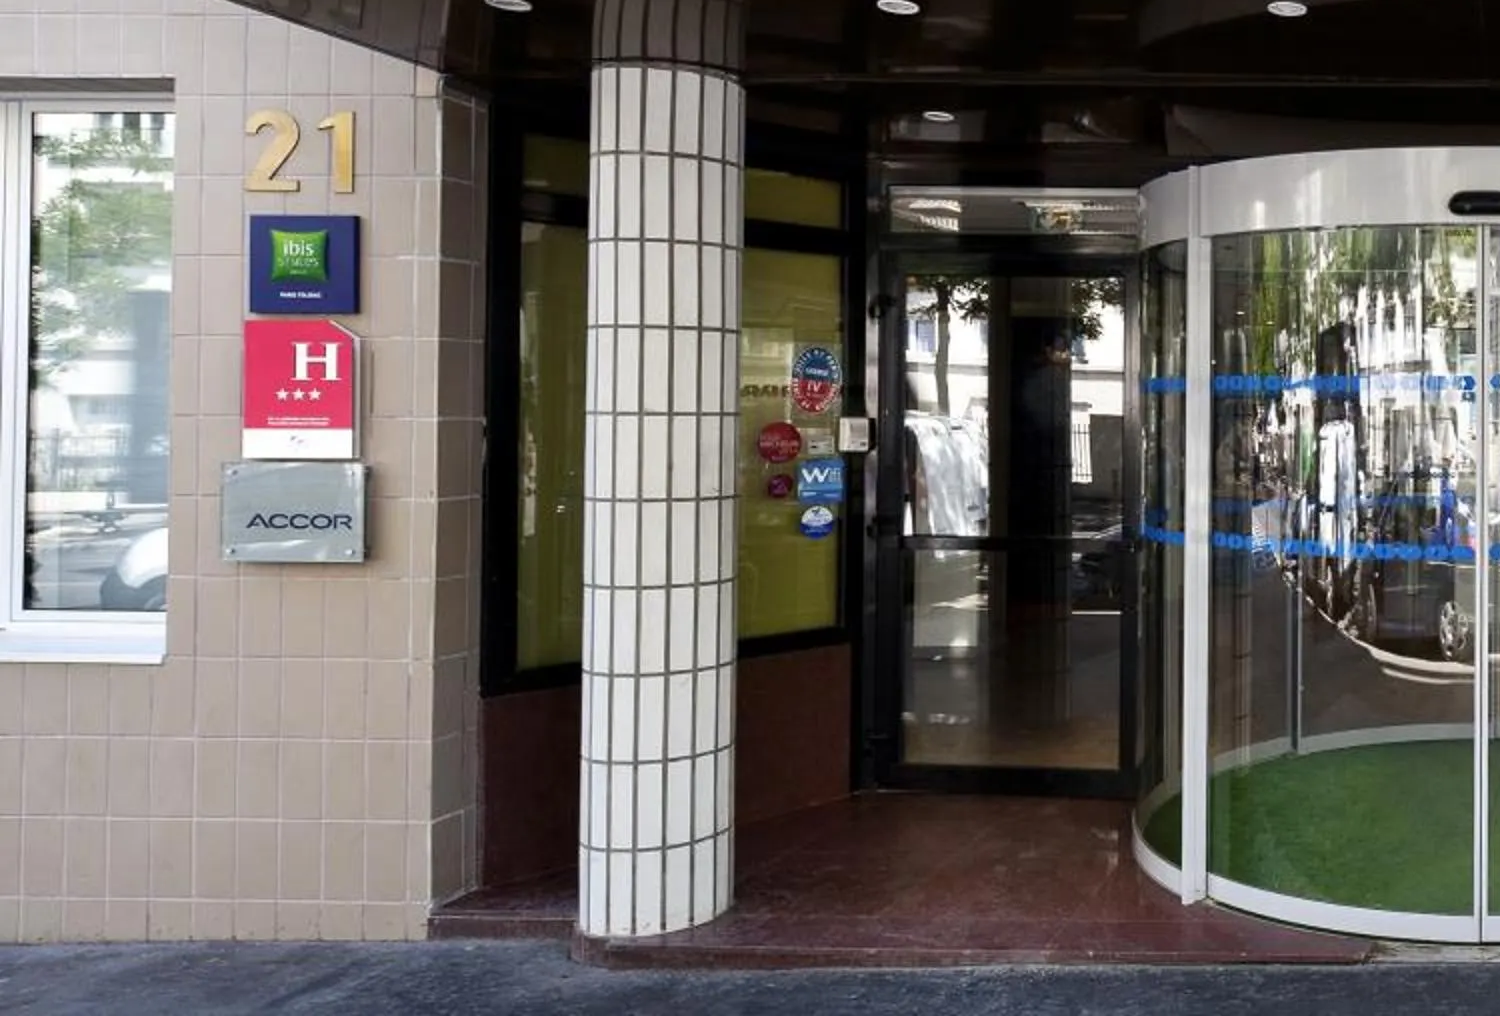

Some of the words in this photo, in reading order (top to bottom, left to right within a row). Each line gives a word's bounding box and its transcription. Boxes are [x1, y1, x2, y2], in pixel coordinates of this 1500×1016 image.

[245, 109, 356, 194] 21
[283, 238, 315, 257] ibis
[290, 342, 343, 381] H
[246, 513, 353, 530] ACCOR
